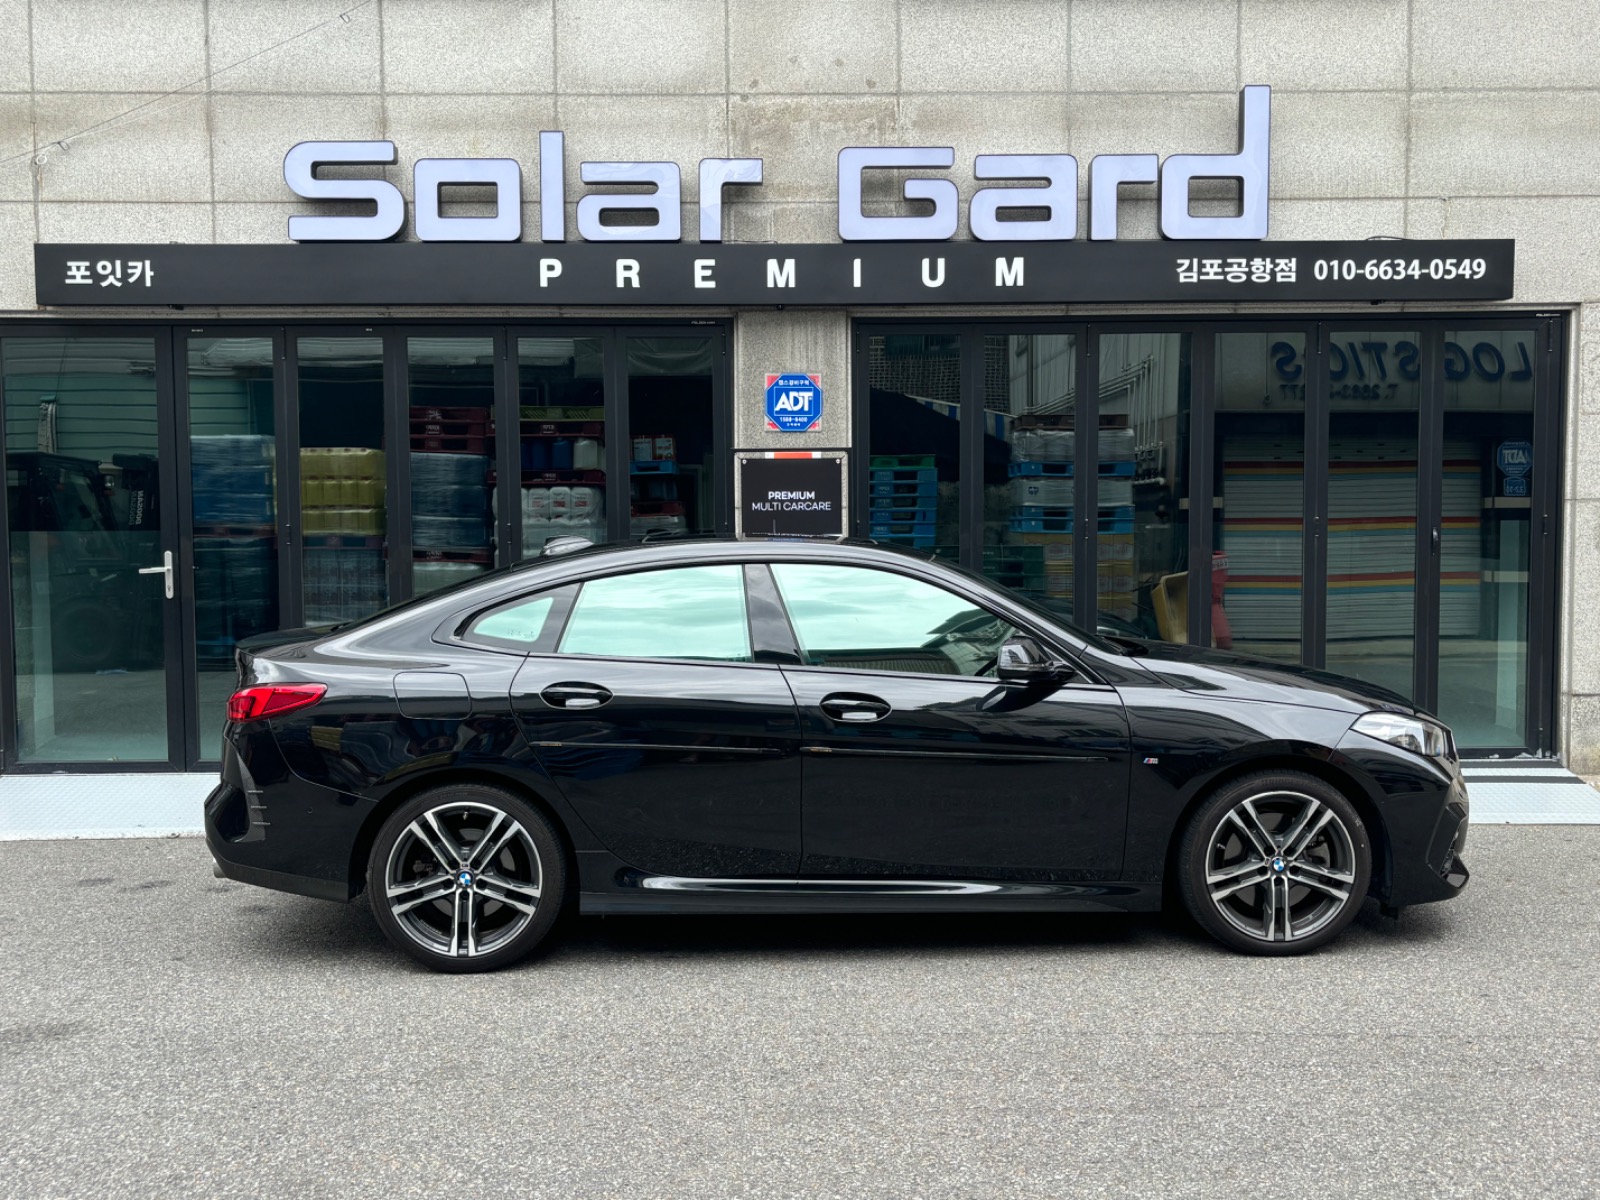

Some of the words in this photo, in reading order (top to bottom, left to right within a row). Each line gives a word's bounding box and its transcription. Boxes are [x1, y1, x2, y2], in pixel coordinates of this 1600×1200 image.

[282, 130, 763, 242] Solar
[837, 84, 1272, 241] Gard
[64, 259, 155, 287] 포잇카
[539, 257, 1025, 288] PREMIUM
[1176, 257, 1297, 283] 김포공항점
[1313, 258, 1487, 281] 010-6634-0549
[774, 391, 813, 412] ADT
[752, 502, 782, 511] MULTI
[783, 501, 832, 511] CARCARE
[768, 490, 816, 500] PREMIUM
